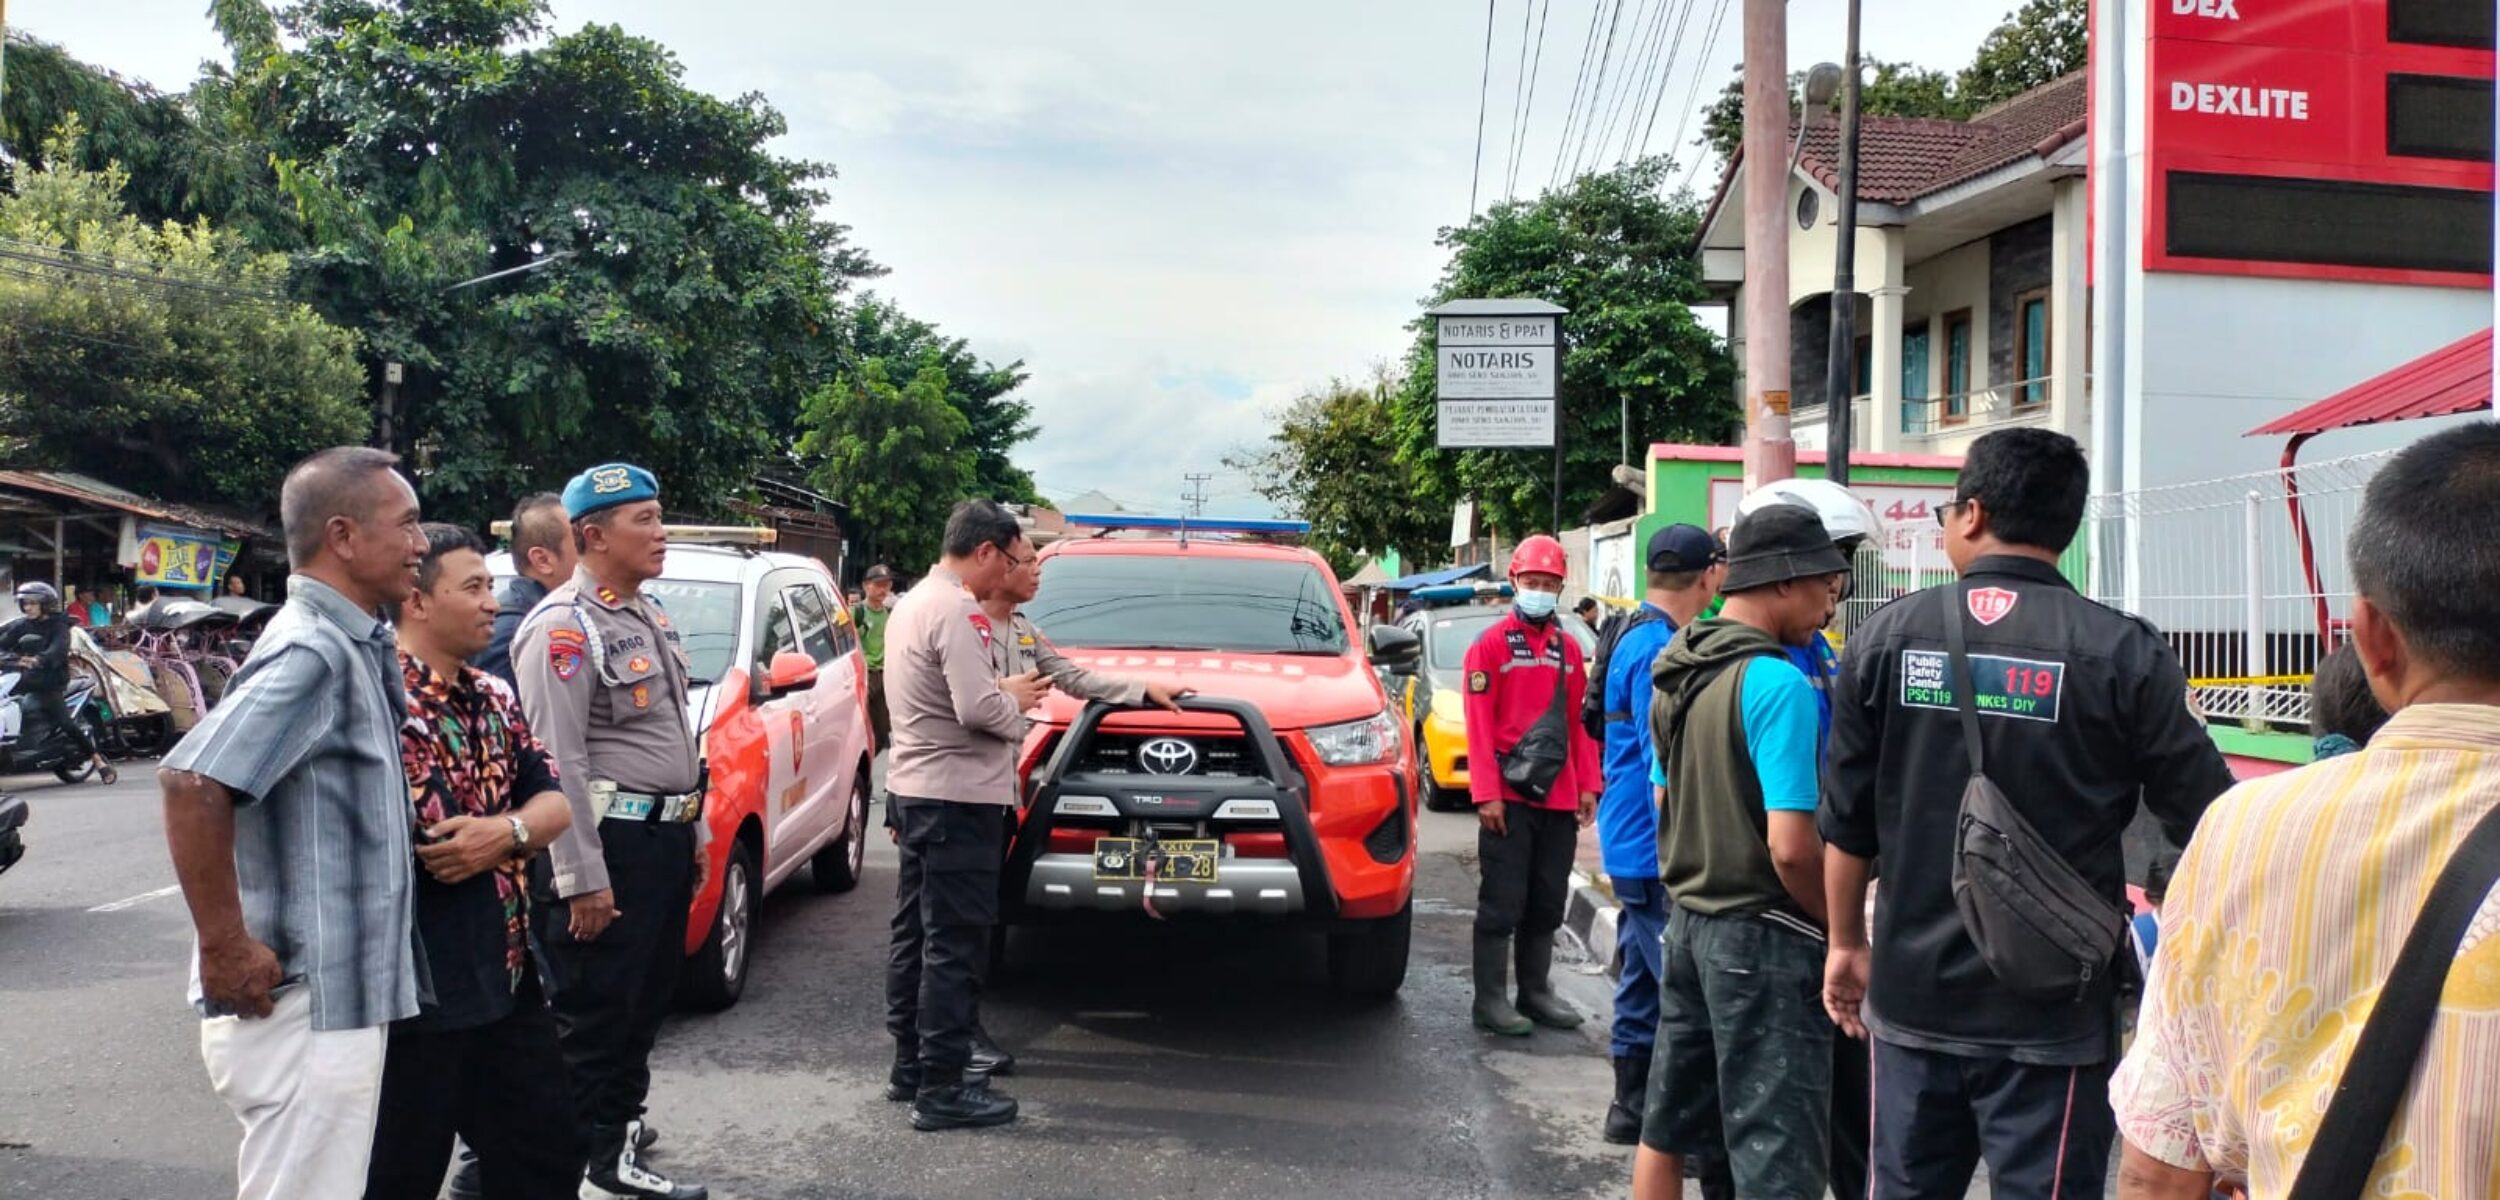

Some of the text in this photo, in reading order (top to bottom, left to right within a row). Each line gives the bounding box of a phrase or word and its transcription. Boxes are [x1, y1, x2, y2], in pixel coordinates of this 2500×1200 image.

[2171, 82, 2308, 120] DEXLITE
[1444, 324, 1495, 338] NOTARIS
[1515, 324, 1546, 337] PPAT
[1451, 352, 1534, 369] NOTARIS
[1975, 596, 2006, 612] 119
[1907, 655, 1943, 667] Public
[1907, 666, 1942, 680] Safety
[1907, 676, 1944, 689] Center
[2006, 667, 2054, 697] 119
[1907, 688, 1930, 701] PSC
[1933, 690, 1951, 704] 119
[2013, 698, 2036, 712] DIY
